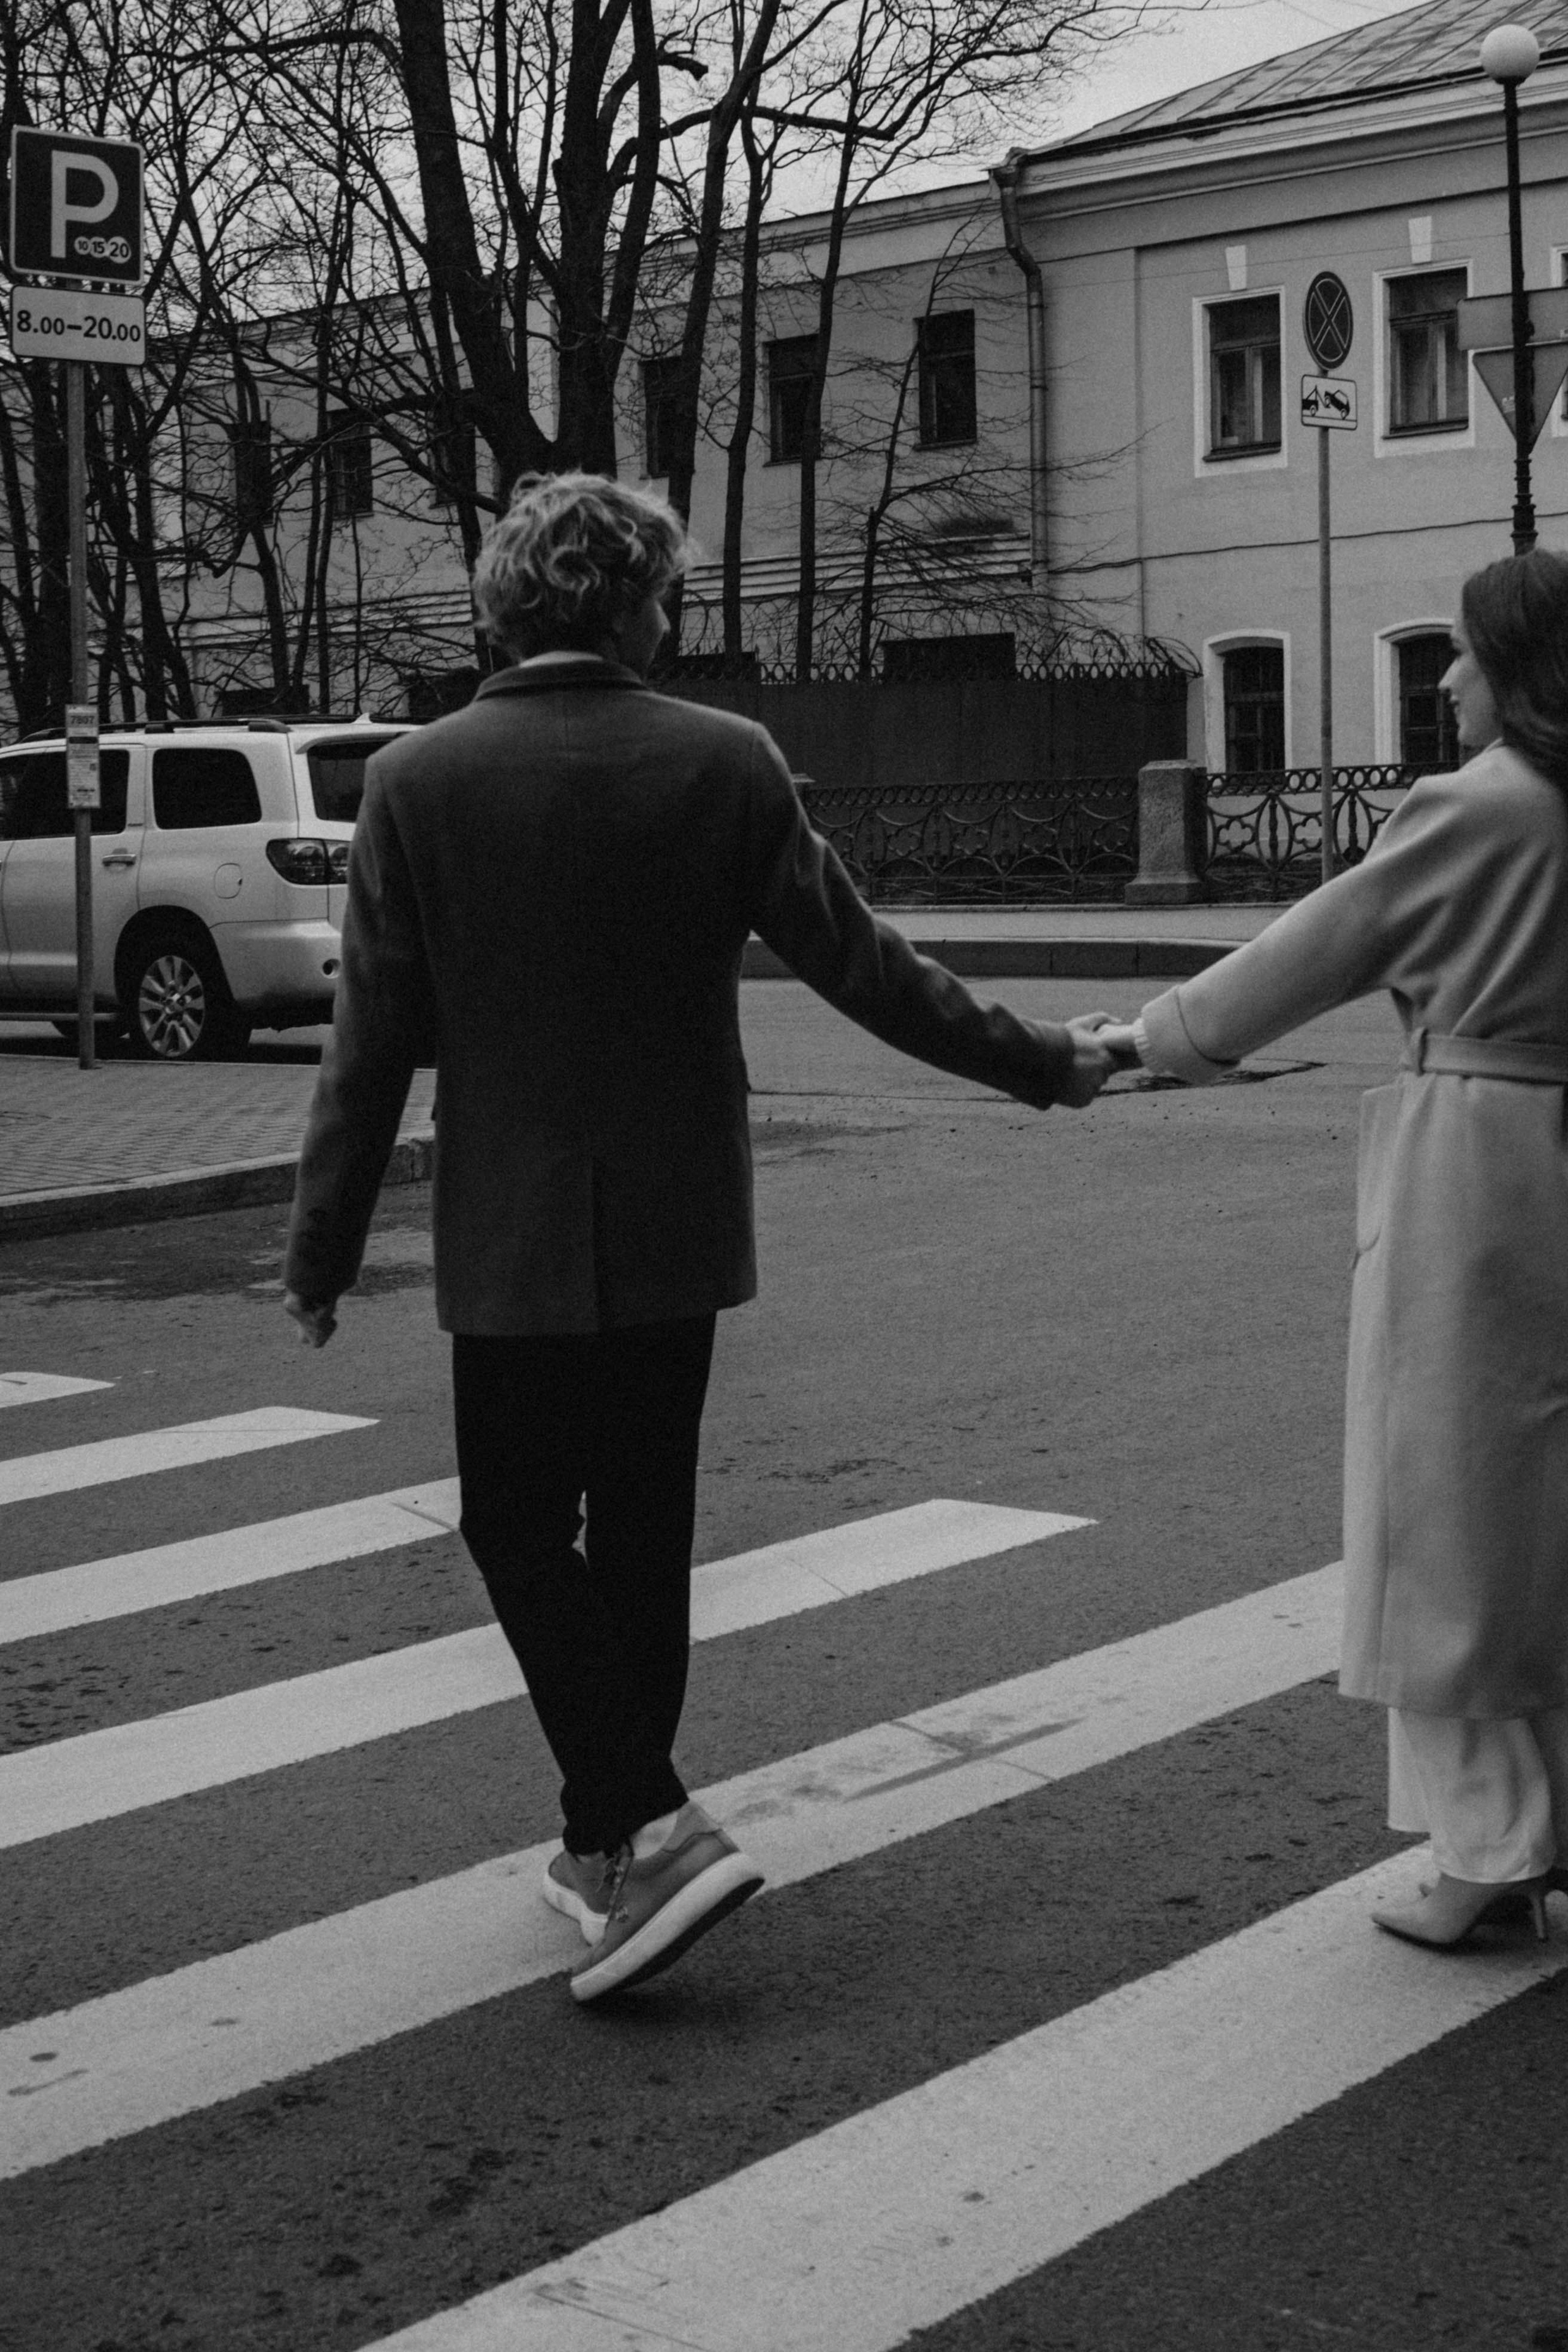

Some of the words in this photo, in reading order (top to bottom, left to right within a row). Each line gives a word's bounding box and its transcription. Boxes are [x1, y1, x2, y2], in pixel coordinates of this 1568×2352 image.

[51, 149, 119, 258] P
[78, 240, 89, 251] 10
[92, 241, 105, 254] 15
[110, 242, 129, 258] 20
